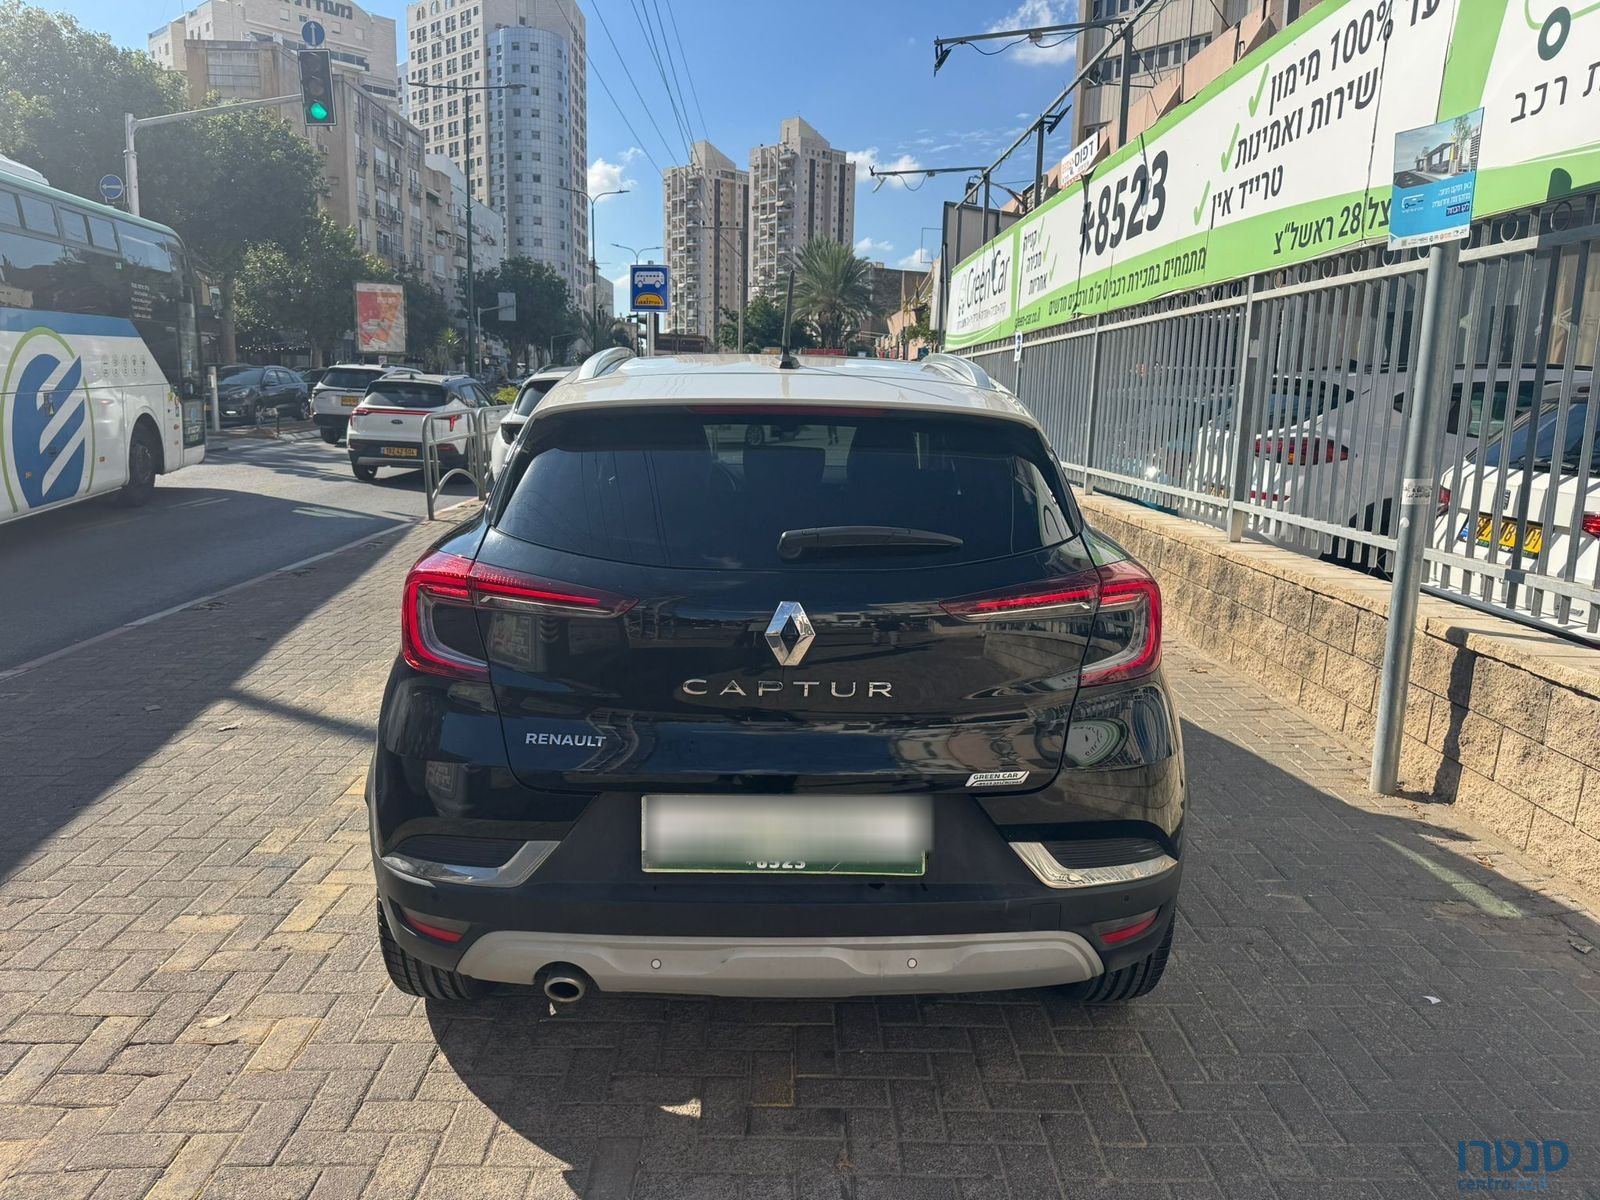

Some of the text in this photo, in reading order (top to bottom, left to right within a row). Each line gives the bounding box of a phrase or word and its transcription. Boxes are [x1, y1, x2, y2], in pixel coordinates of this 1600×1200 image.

[1331, 0, 1393, 71] 100%
[1269, 49, 1321, 116] מימון
[1510, 75, 1568, 123] רכב
[1235, 67, 1378, 169] שירות ואמינות
[1211, 165, 1284, 229] טרייד אין
[1368, 197, 1392, 229] צל
[1338, 202, 1361, 237] 28
[1126, 264, 1160, 292] במכירת
[1162, 247, 1206, 281] מתמחים
[682, 679, 893, 698] CAPTUR
[525, 733, 606, 747] RENAULT
